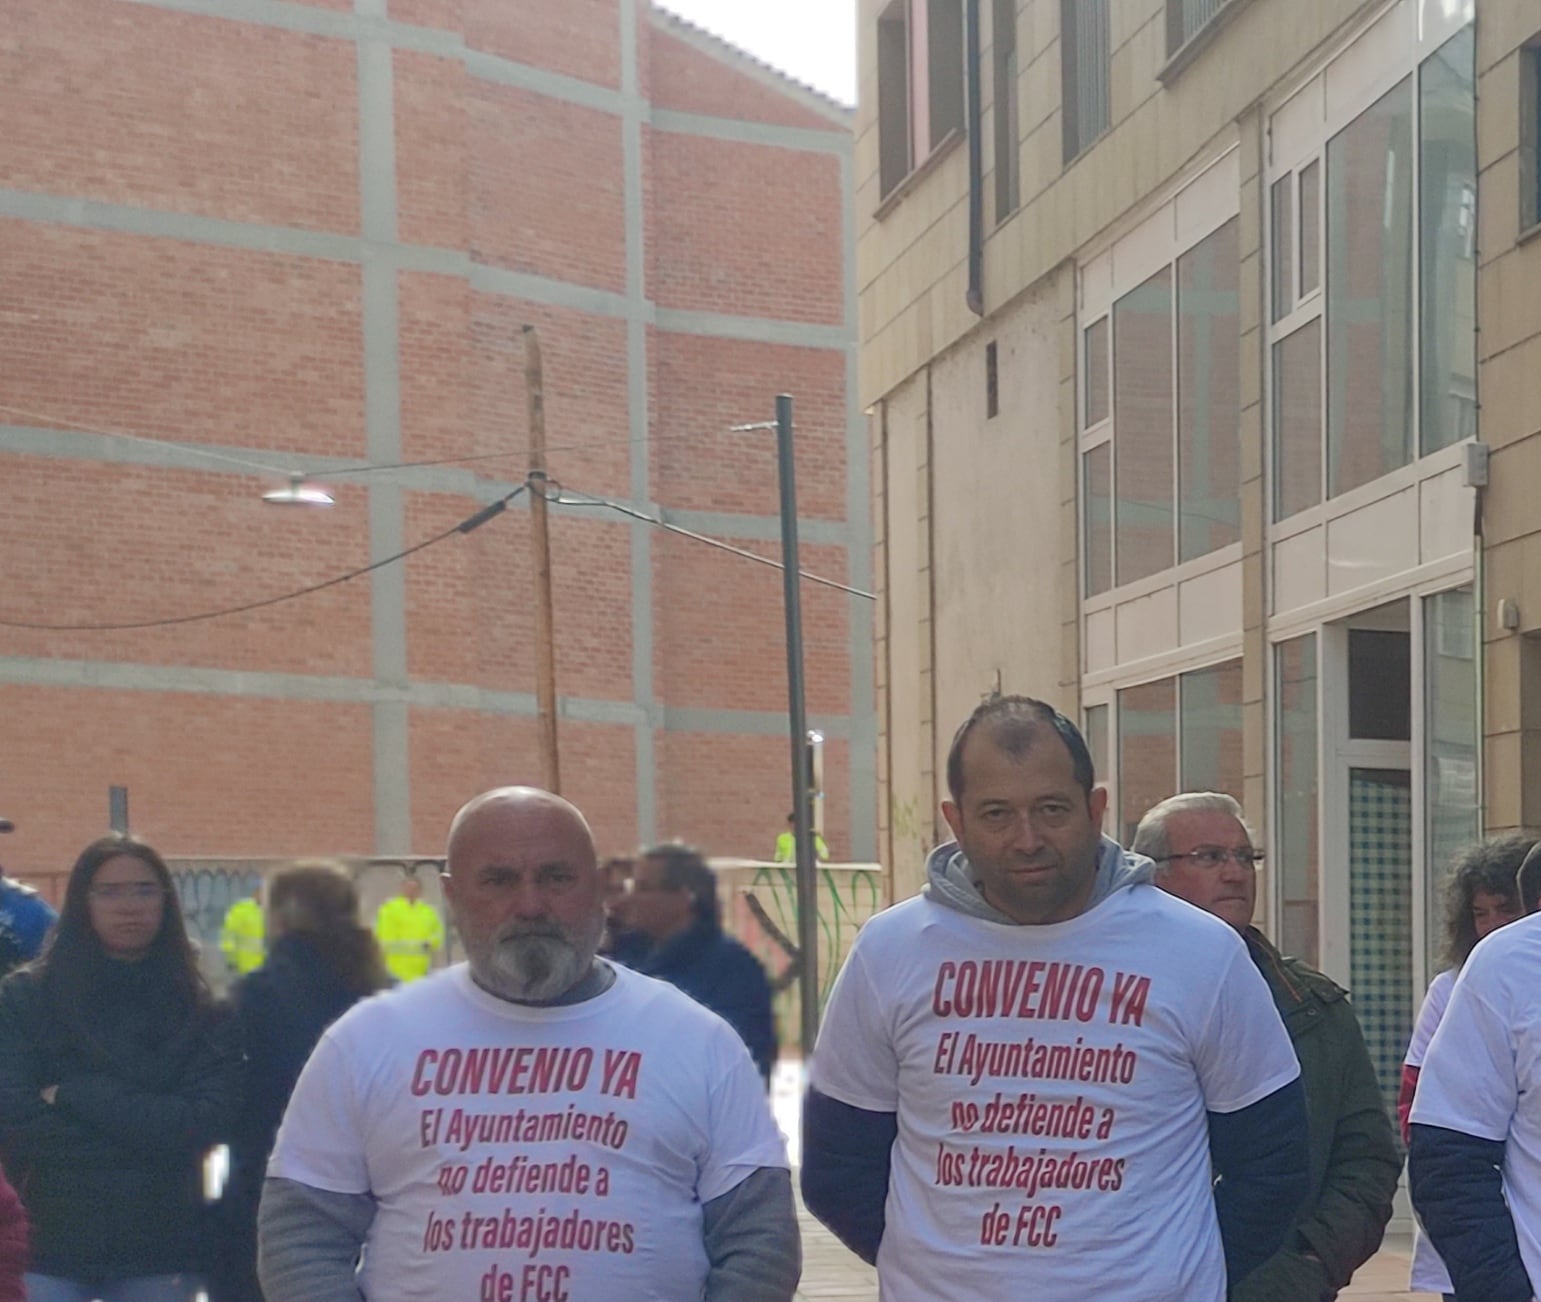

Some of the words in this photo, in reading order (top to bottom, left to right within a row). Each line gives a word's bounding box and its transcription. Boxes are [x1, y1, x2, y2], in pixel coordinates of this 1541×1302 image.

[932, 960, 1105, 1023] CONVENIO
[1108, 972, 1151, 1027] YA
[410, 1047, 594, 1096] CONVENIO
[600, 1049, 642, 1099] YA
[934, 1032, 960, 1075] El
[958, 1033, 1136, 1086] Ayuntamiento
[420, 1108, 443, 1148] El
[444, 1103, 628, 1152] Ayuntamiento
[952, 1101, 979, 1132] no
[980, 1093, 1094, 1139] defiende
[1097, 1107, 1114, 1140] a
[437, 1165, 468, 1196] no
[472, 1154, 590, 1194] defiende
[595, 1167, 609, 1196] a
[935, 1143, 965, 1186] los
[969, 1146, 1125, 1198] trabajadores
[423, 1211, 455, 1252] los
[460, 1207, 634, 1258] trabajadores
[980, 1202, 1010, 1246] de
[1013, 1206, 1061, 1247] FCC
